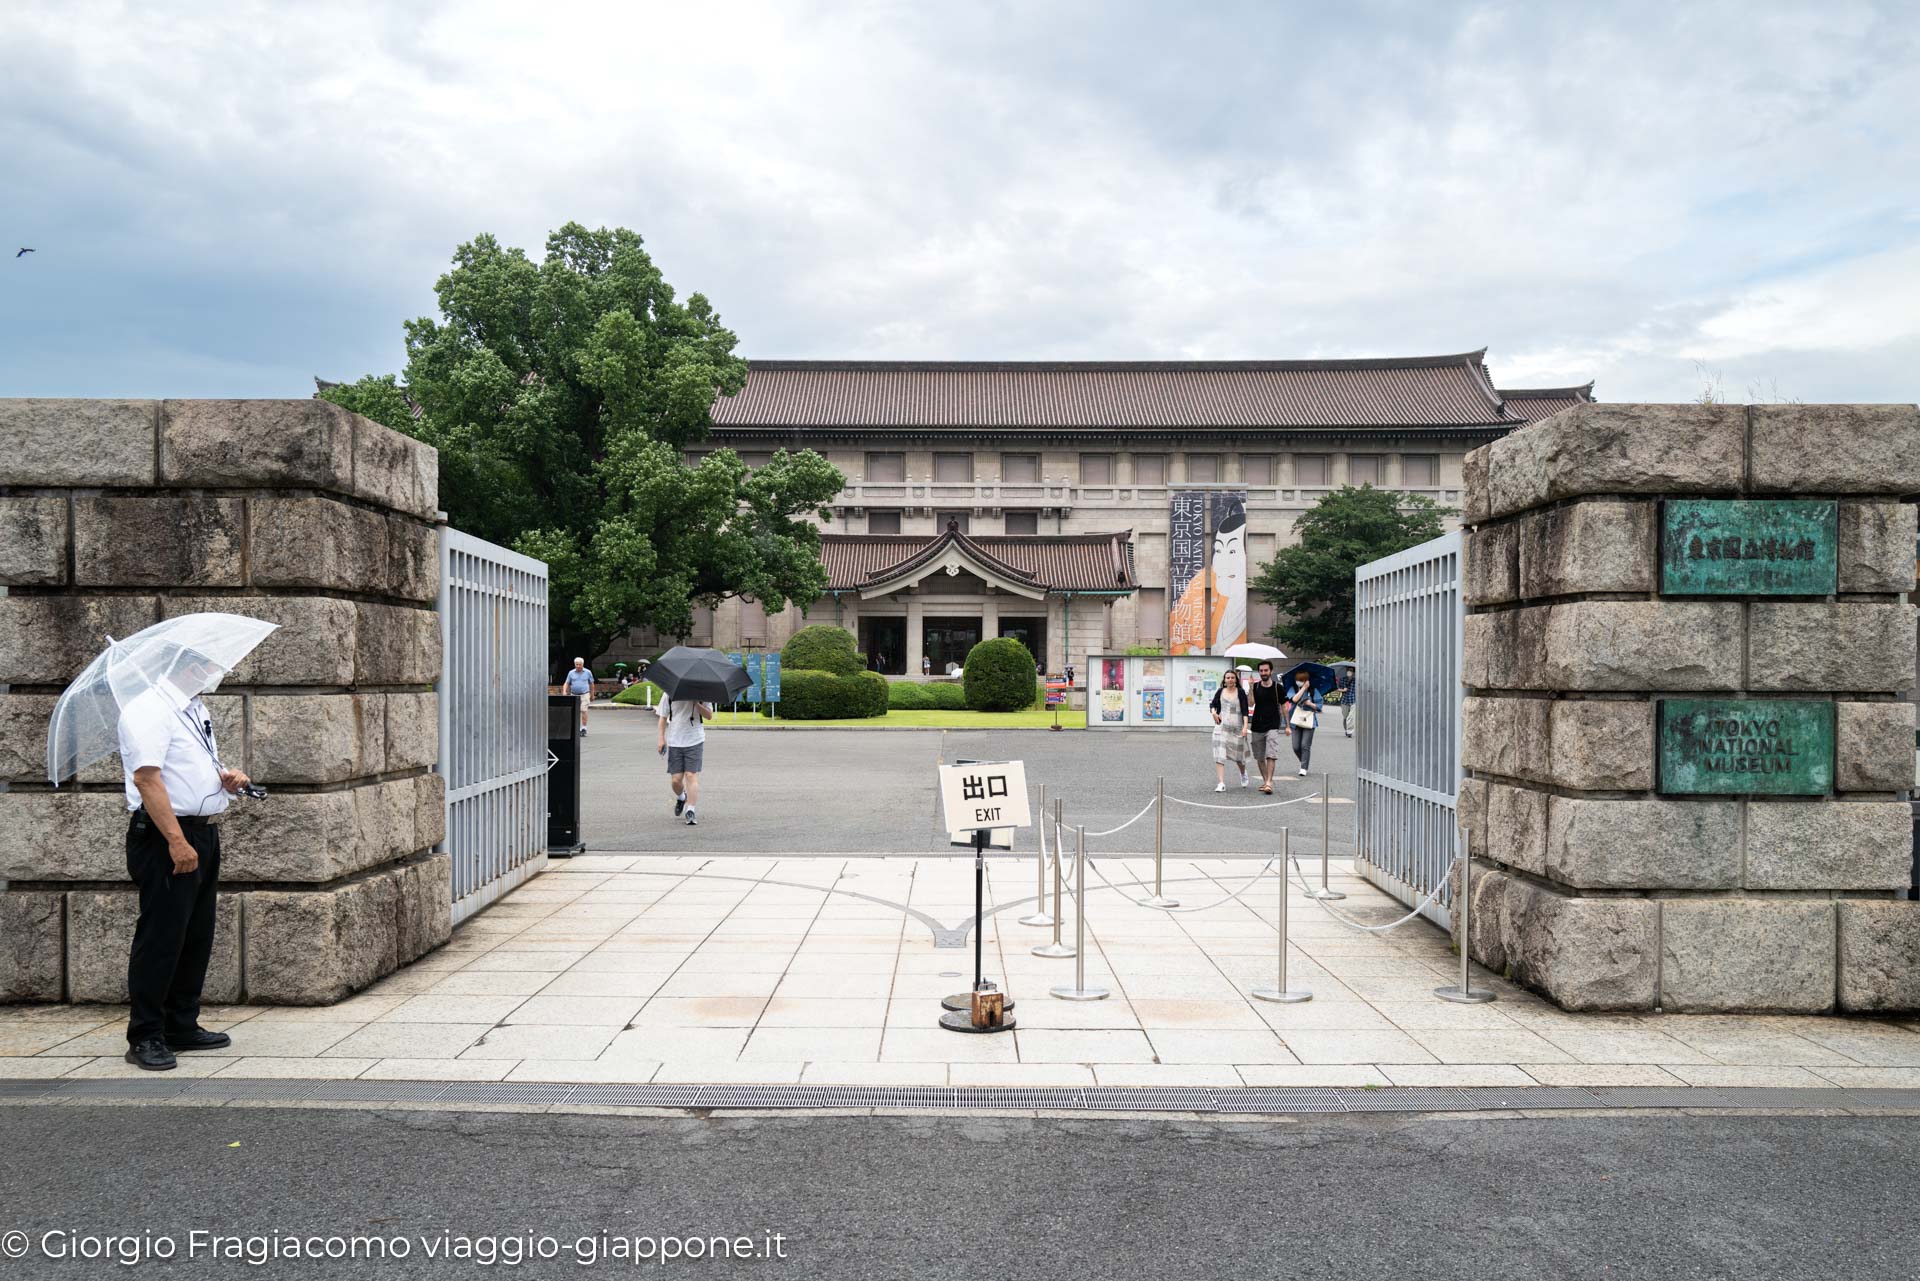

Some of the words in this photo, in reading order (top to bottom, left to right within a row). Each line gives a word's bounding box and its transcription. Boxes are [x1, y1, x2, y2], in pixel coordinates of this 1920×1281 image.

[1192, 498, 1203, 536] TOKYO
[1171, 496, 1192, 642] 東京国立博物館
[1192, 539, 1203, 592] NATIONAL
[1192, 597, 1203, 641] MUSEUM
[1714, 719, 1780, 737] TOKYO
[1700, 737, 1799, 756] NATIONAL
[1704, 756, 1792, 774] MUSEUM
[962, 775, 1008, 801] 出口
[975, 807, 1002, 822] EXIT
